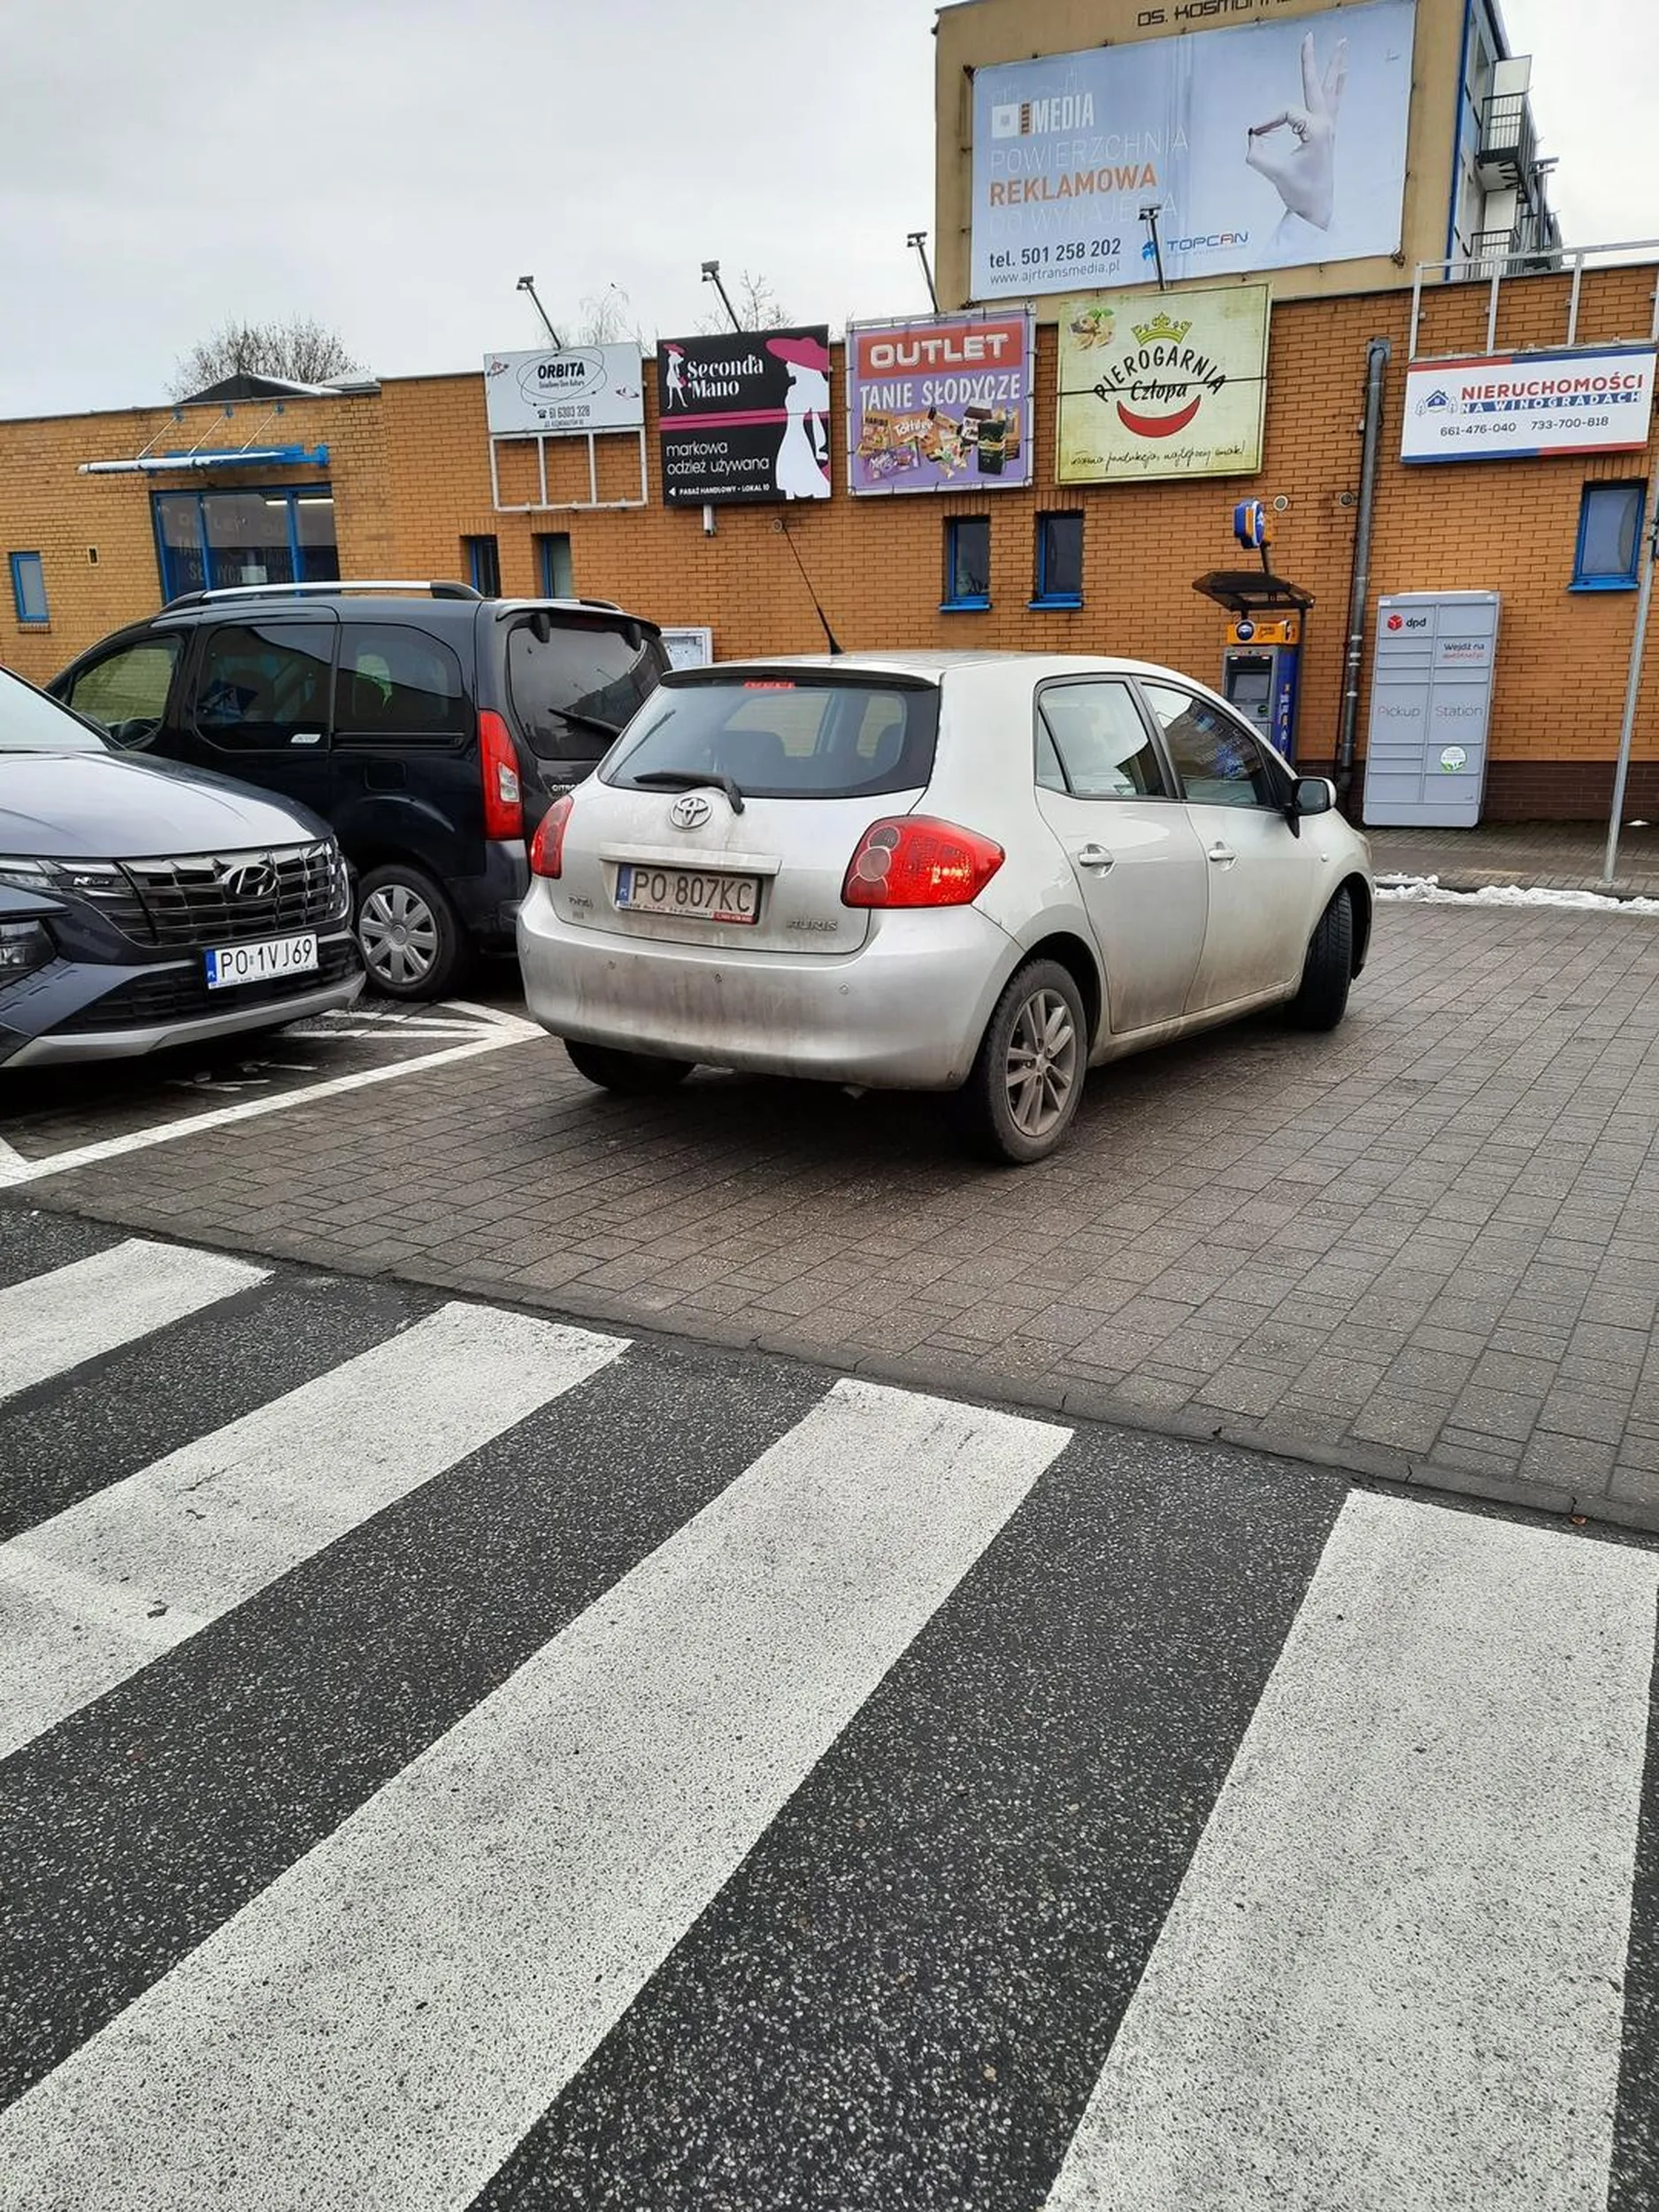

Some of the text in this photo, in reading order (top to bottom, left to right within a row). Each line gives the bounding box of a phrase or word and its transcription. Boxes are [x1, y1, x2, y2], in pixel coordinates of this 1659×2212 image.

[1137, 0, 1292, 27] OS. KOSMON
[1032, 93, 1094, 134] MEDIA
[990, 124, 1189, 174] POWIERZCHNIA
[989, 162, 1157, 206] REKLAMOWA
[1166, 231, 1250, 251] TOPCAN
[989, 238, 1121, 269] tel. 501 258 202
[990, 260, 1120, 284] www.ajrtransmedia.pl
[870, 333, 1010, 369] OUTLET
[537, 361, 585, 380] ORBITA
[687, 354, 764, 379] Seconda
[1094, 346, 1226, 403] PIEROGARNIA
[687, 380, 740, 398] Mano
[860, 373, 1021, 412] TANIE SŁODYCZE
[1462, 372, 1643, 400] NIERUCHOMOŚCI
[1462, 392, 1640, 414] NA WINOGRADACH
[1440, 416, 1609, 437] 661-476-040 733-700-818
[666, 440, 728, 457] markowa
[667, 457, 770, 476] odzież używana
[741, 484, 762, 493] LOKAL
[1406, 618, 1426, 629] dpd
[1378, 705, 1420, 718] Pickup
[1435, 705, 1483, 717] Station
[633, 871, 753, 912] PO 807KC
[221, 939, 312, 978] PO 1VJ69
